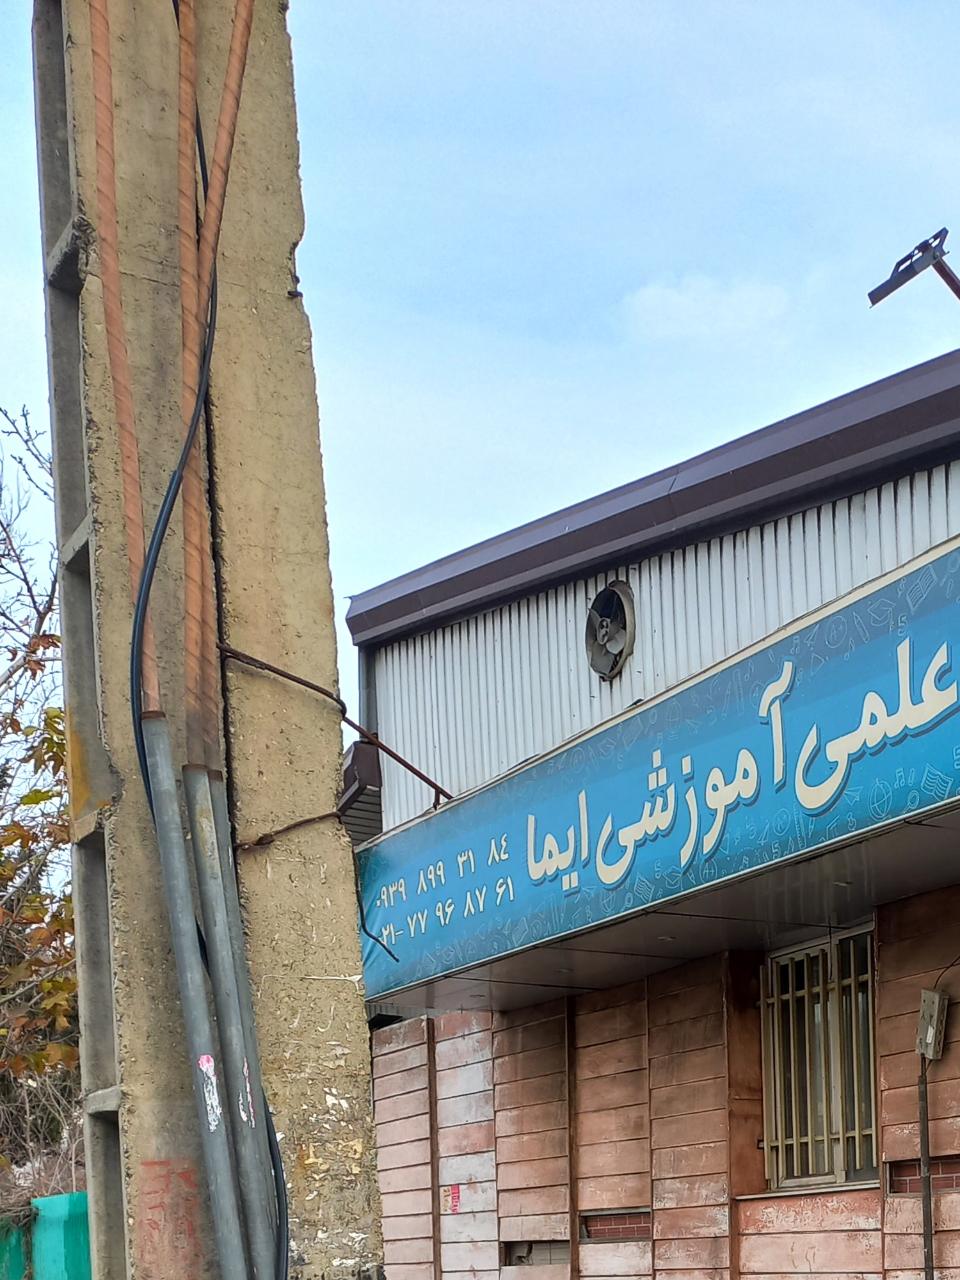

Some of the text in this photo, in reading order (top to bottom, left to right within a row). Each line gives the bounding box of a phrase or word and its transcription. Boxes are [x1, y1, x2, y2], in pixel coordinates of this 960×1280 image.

[597, 661, 795, 884] آموزشی
[795, 636, 960, 812] علمی
[417, 861, 446, 895] ۸۹۹
[457, 849, 475, 878] ۳۱
[527, 790, 590, 890] ایما
[407, 909, 428, 938] ۷۷
[435, 898, 455, 927] ۹۶
[464, 885, 487, 918] ۸۷
[495, 876, 515, 906] ۶۱
